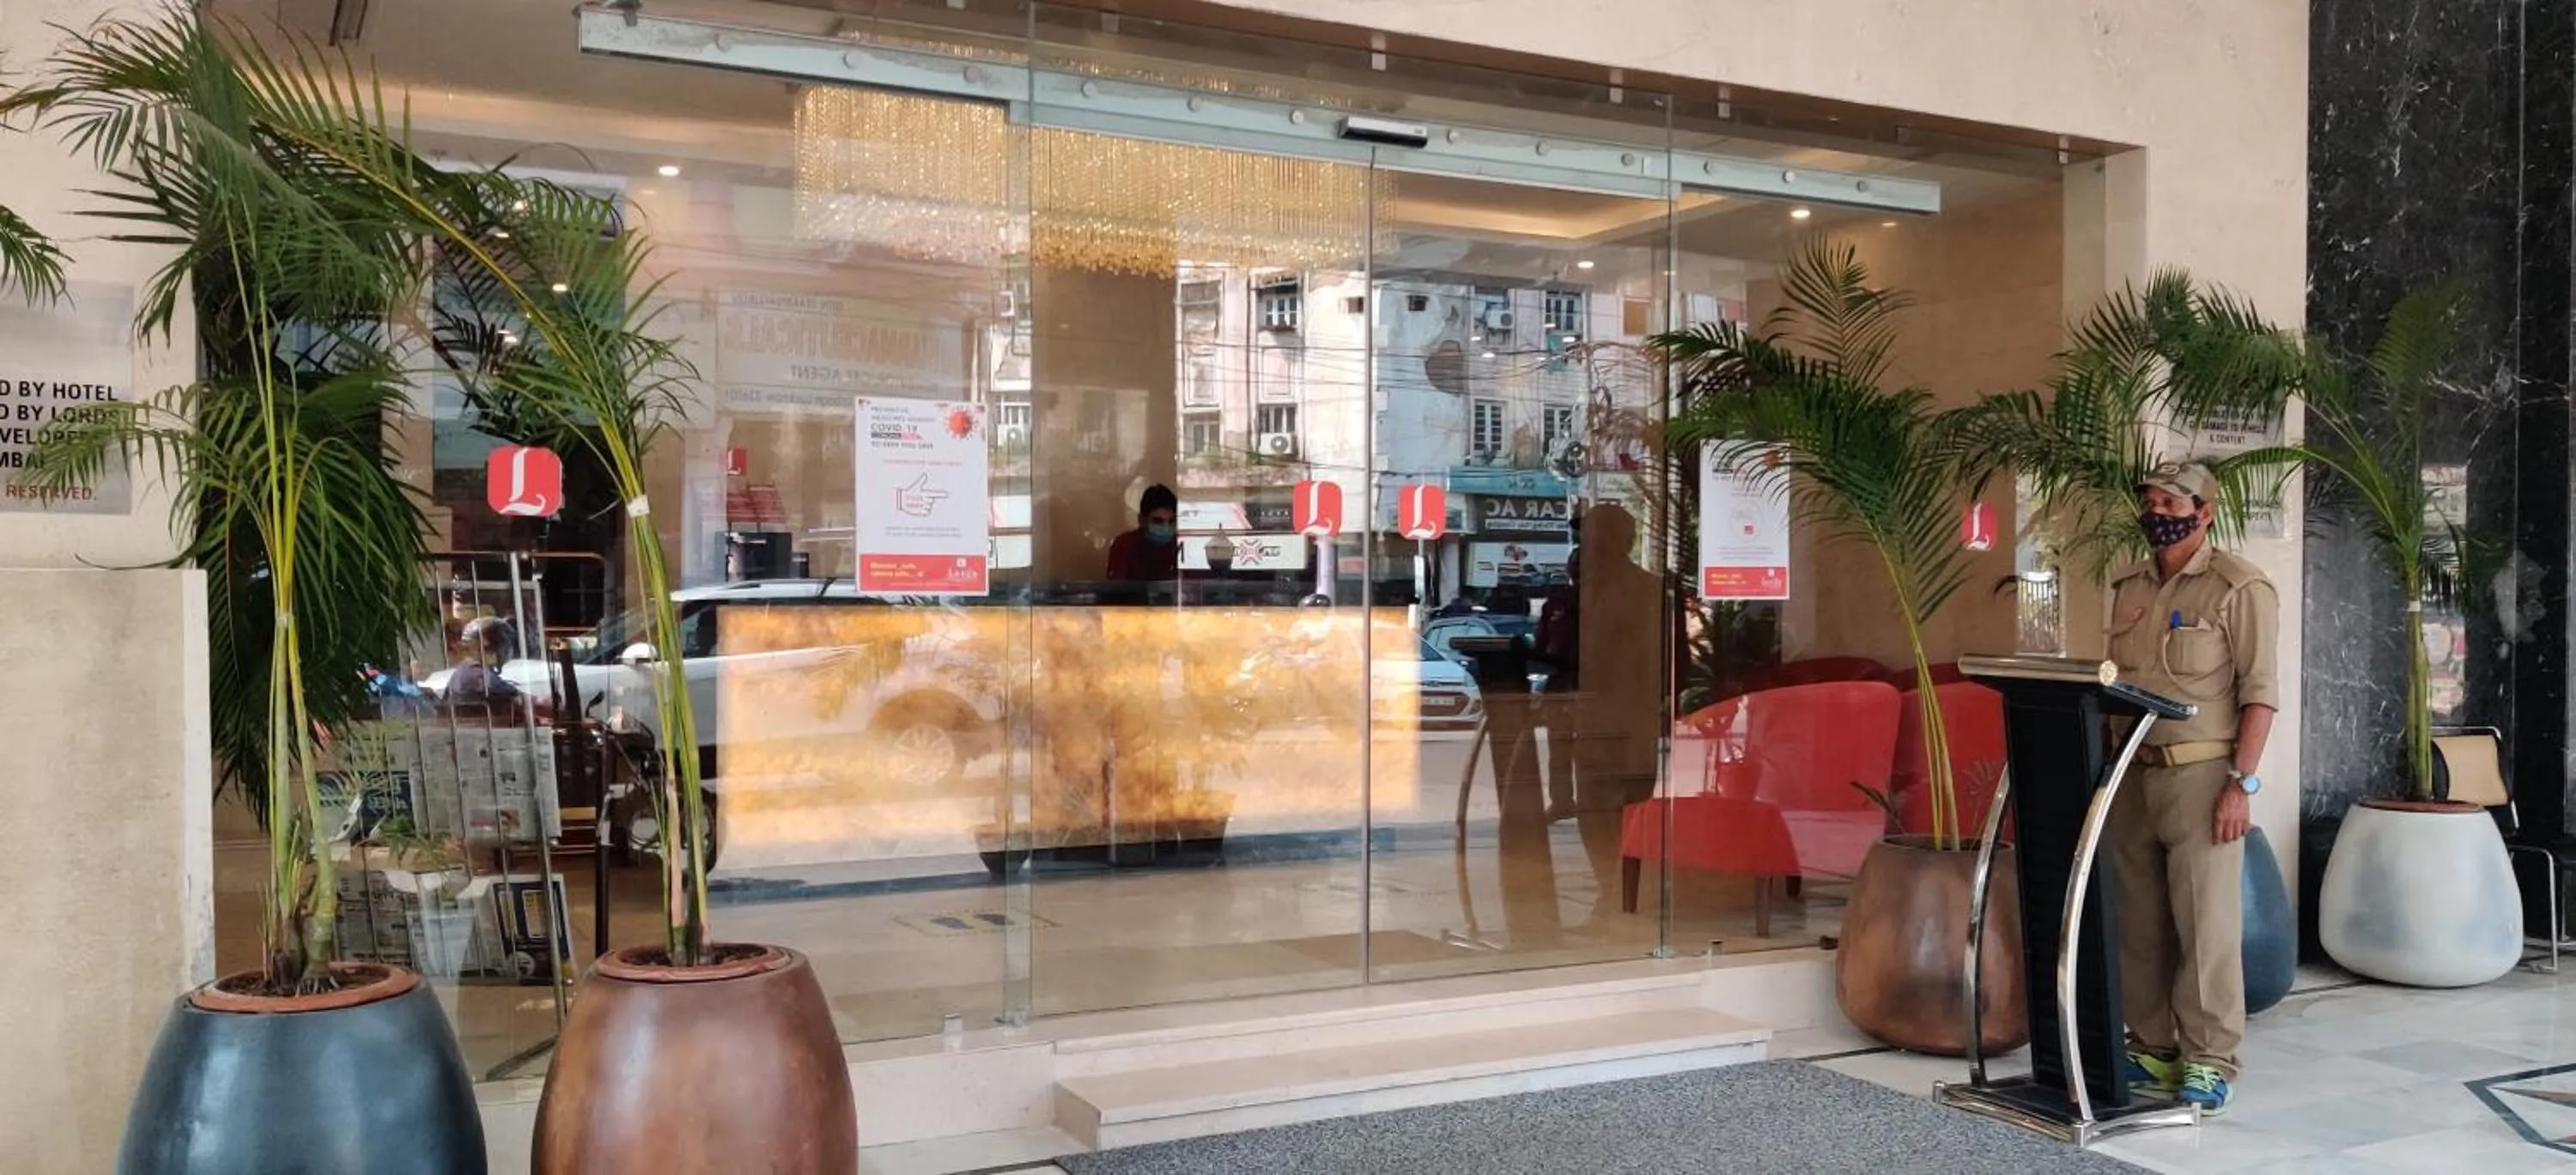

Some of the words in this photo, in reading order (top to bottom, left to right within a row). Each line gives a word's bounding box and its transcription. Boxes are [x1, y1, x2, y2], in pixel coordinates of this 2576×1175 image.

[19, 381, 46, 398] BY
[53, 382, 118, 401] HOTEL
[17, 405, 43, 421] BY
